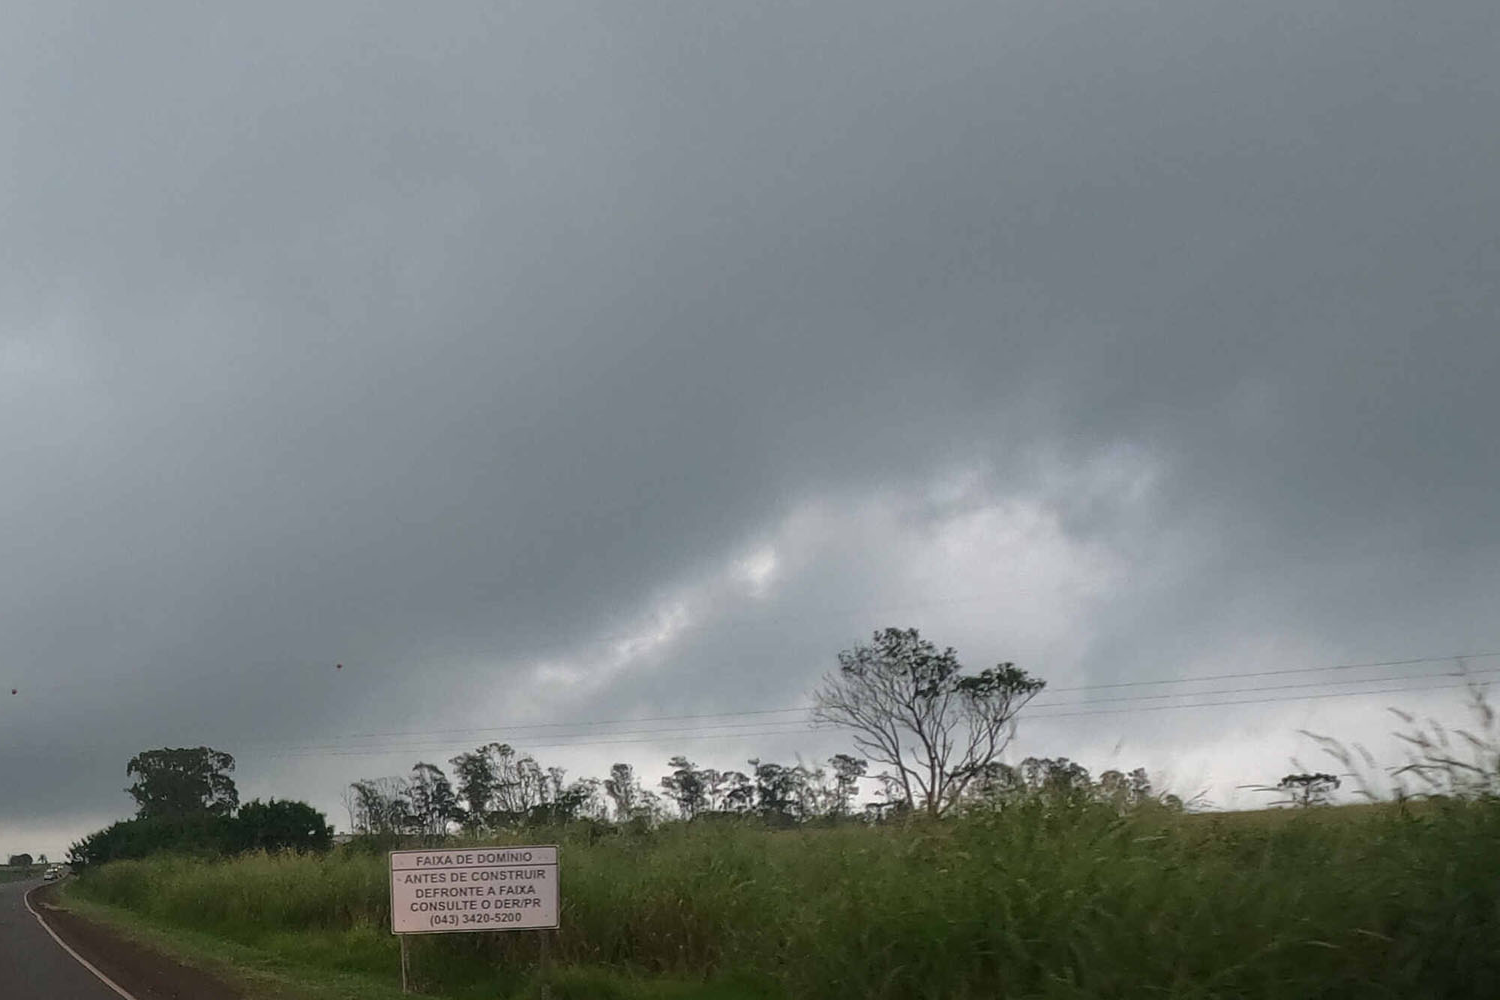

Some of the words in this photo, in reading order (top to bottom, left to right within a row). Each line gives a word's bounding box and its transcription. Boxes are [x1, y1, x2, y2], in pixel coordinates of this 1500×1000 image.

[417, 856, 452, 866] FAIXA
[457, 855, 473, 864] DE
[405, 873, 446, 884] ANTES
[451, 872, 467, 881] DE
[471, 870, 546, 881] CONSTRUIR
[416, 887, 483, 898] DEFRONTE
[500, 886, 535, 894] FAIXA
[411, 901, 477, 912] CONSULTE
[482, 900, 490, 909] O
[495, 898, 541, 908] DER/PR
[430, 915, 459, 926] (043)
[463, 913, 521, 923] 3420-5200
